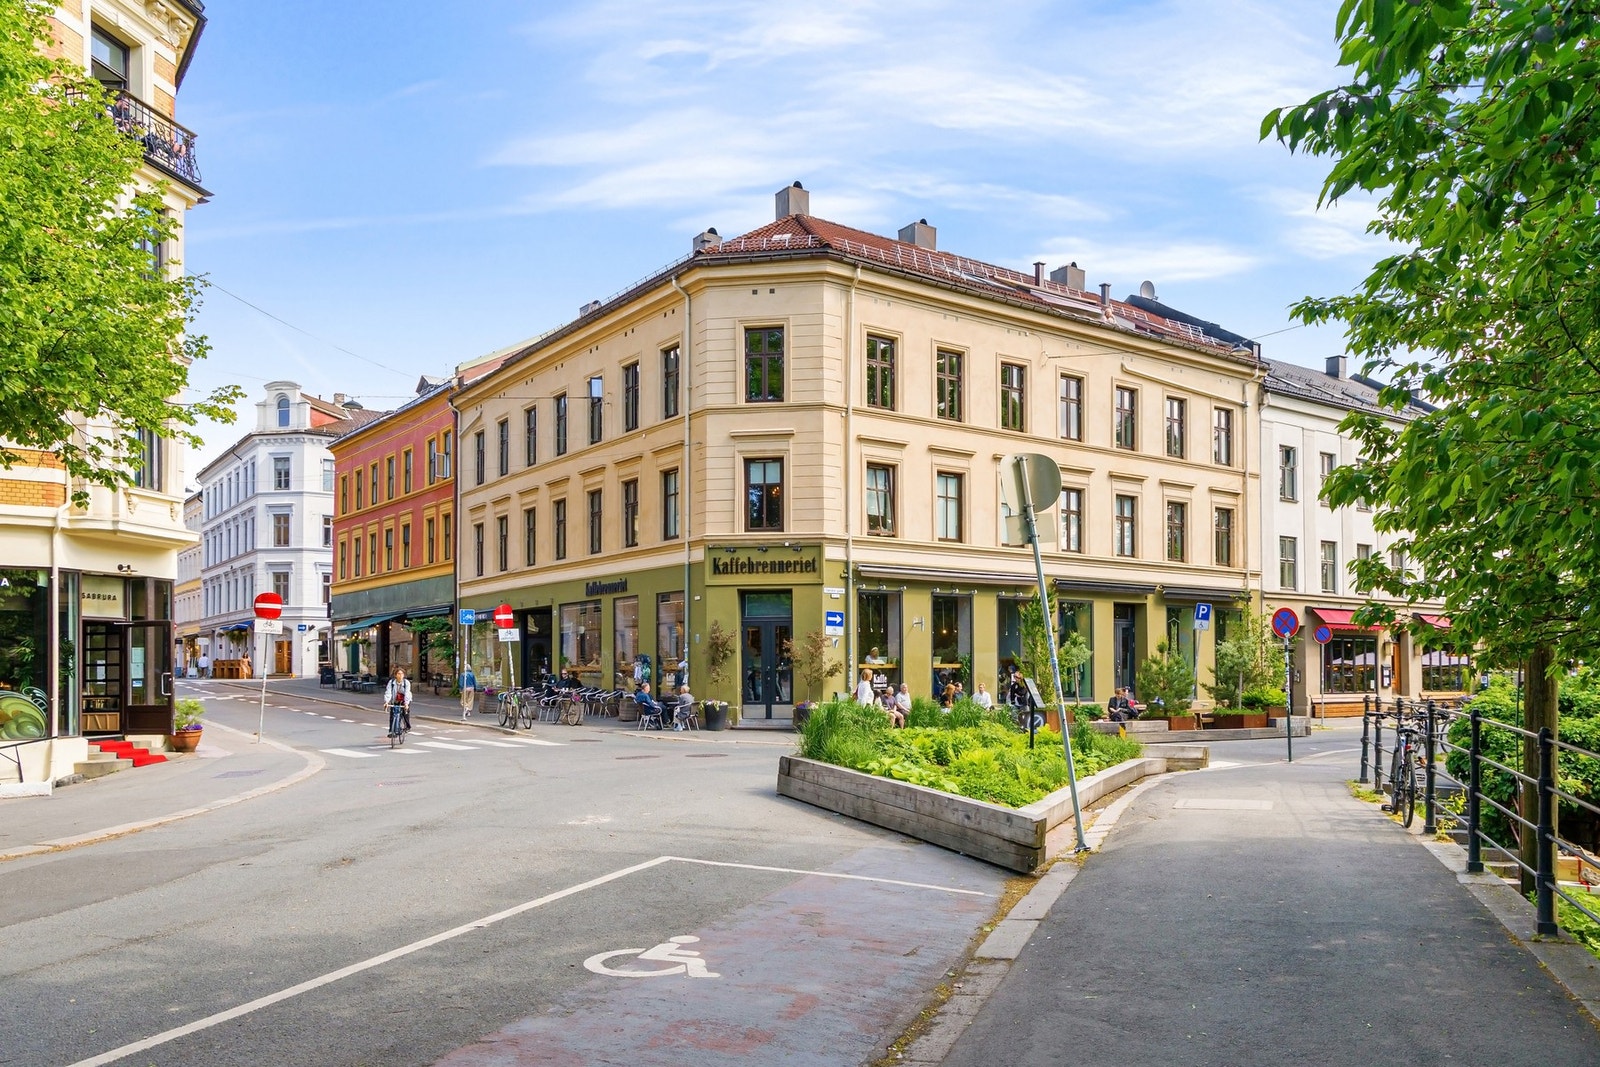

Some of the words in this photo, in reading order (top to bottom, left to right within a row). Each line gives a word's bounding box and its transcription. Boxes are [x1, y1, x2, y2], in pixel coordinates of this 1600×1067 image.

[712, 557, 817, 575] Kaffebrenneriet
[81, 592, 117, 601] SABRURA
[1198, 606, 1208, 618] P
